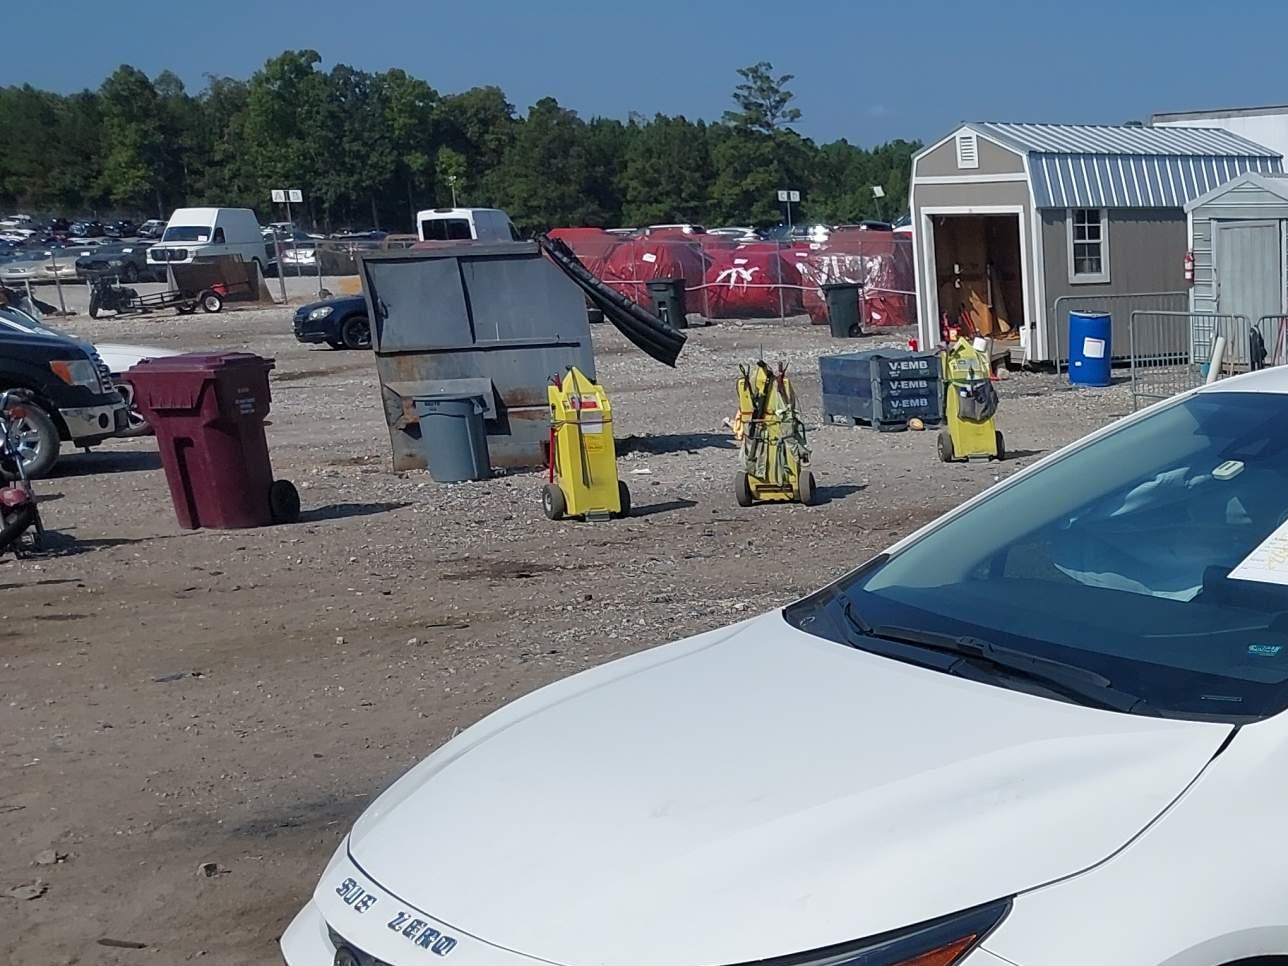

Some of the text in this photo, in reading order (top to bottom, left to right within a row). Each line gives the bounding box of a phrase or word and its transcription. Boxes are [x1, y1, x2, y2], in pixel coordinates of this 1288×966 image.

[888, 361, 928, 370] V-EMB
[890, 381, 927, 390] V-EMB
[891, 399, 928, 408] V-EMB
[387, 911, 458, 956] ZERO
